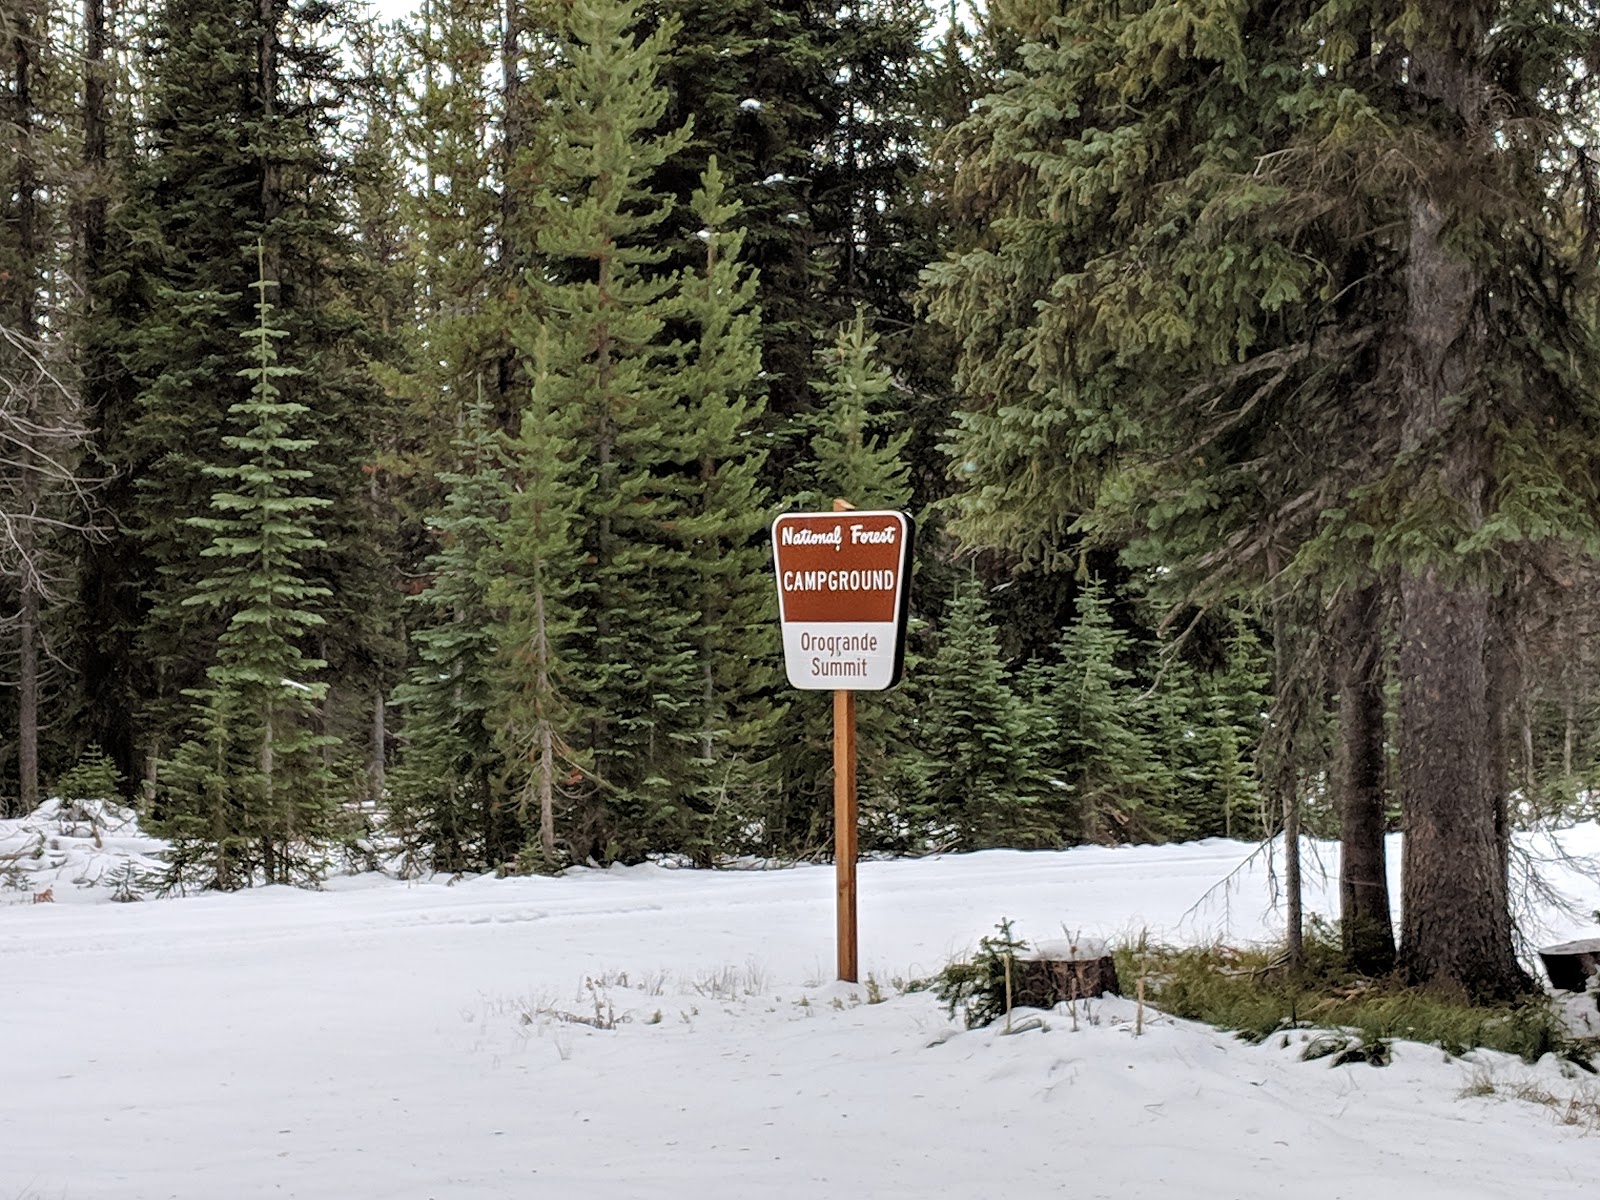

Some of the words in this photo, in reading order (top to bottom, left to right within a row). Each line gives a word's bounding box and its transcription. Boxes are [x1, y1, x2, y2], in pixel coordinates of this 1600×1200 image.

[781, 525, 842, 546] National
[850, 524, 897, 544] Forest
[783, 570, 894, 591] CAMPGROUND
[801, 632, 878, 657] Orogrande
[811, 657, 868, 676] Summit
